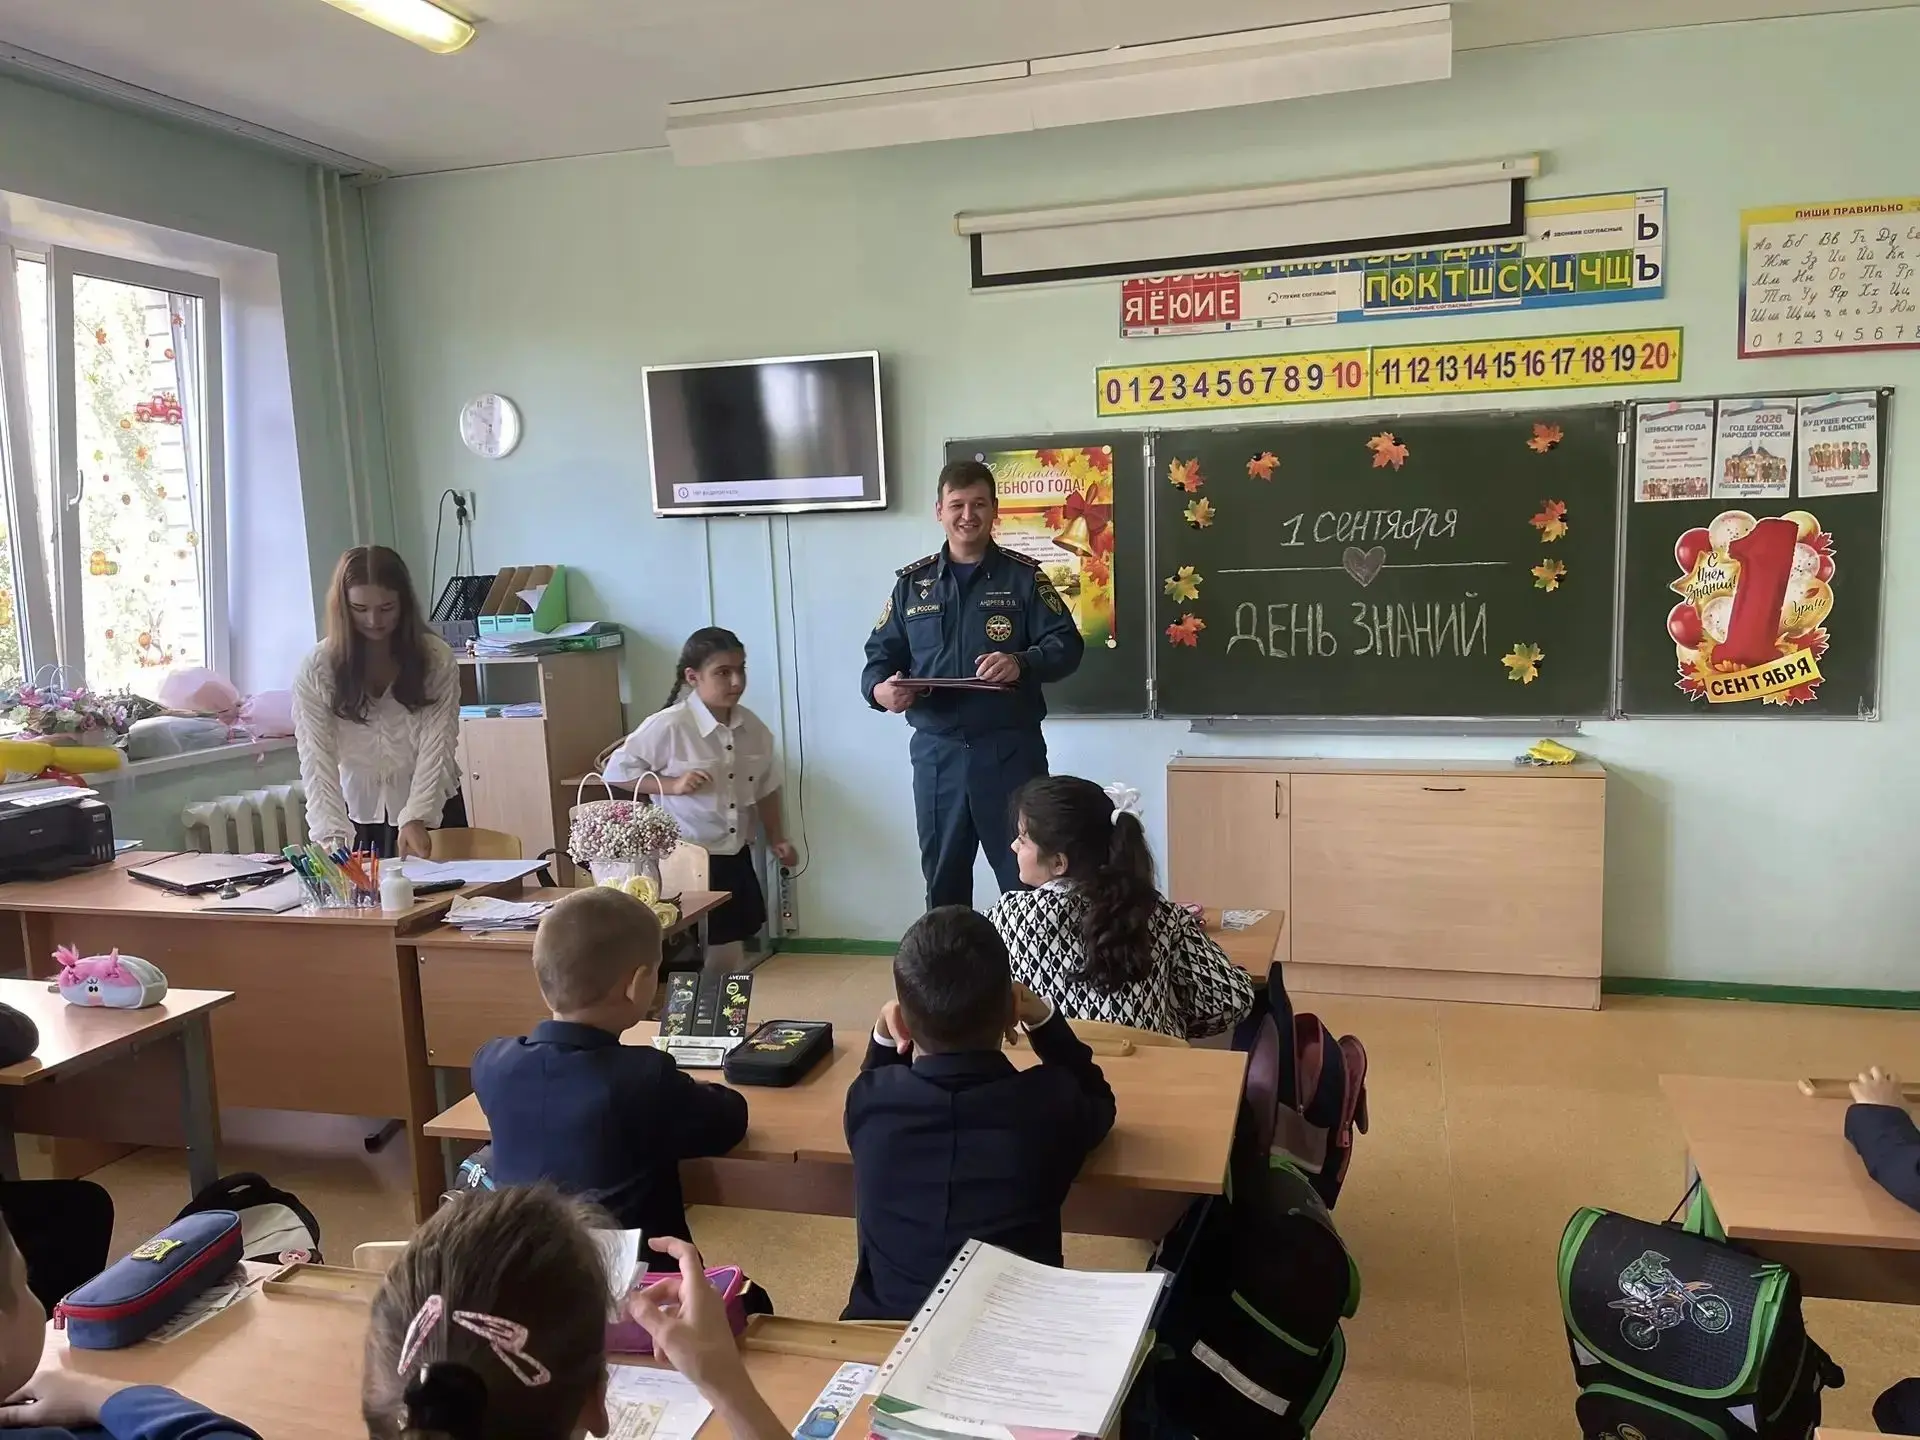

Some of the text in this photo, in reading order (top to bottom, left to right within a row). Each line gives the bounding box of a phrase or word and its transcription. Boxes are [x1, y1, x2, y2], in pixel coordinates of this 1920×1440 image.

[1795, 203, 1904, 219] ПИШИ ПРАВИЛЬНО
[1583, 226, 1623, 235] СОГЛАСНЫЕ
[1637, 213, 1659, 240] Ь
[1635, 254, 1660, 281] Ъ
[1302, 290, 1337, 298] СОГЛАСНЫЕ
[1752, 333, 1762, 348] 0
[1777, 332, 1783, 344] 1
[1794, 331, 1803, 345] 2
[1813, 330, 1823, 344] 3
[1835, 329, 1843, 341] 4
[1853, 327, 1864, 341] 5
[1874, 326, 1883, 340] 6
[1896, 325, 1904, 339] 7
[1381, 358, 1400, 384] 11
[1407, 357, 1430, 383] 12
[1435, 355, 1458, 382] 13
[1463, 353, 1488, 380] 14
[1492, 351, 1516, 378] 15
[1521, 350, 1545, 377] 16
[1551, 347, 1576, 375] 17
[1581, 346, 1605, 373] 18
[1611, 344, 1635, 372] 19
[1640, 342, 1669, 370] 20
[1755, 414, 1782, 424] 2026
[1802, 414, 1875, 427] БУДУЩЕЕ РОССИИ
[1828, 422, 1867, 432] ЕДИНСТВЕ
[1645, 423, 1707, 434] ЦЕННОСТИ ГОДА
[997, 478, 1085, 495] ЕБНОГО ГОДА!
[1280, 513, 1305, 546] 1
[1707, 552, 1718, 568] С
[1697, 566, 1725, 584] Днем
[917, 604, 939, 613] РОССИИ
[1784, 598, 1826, 626] Ура!!!
[1226, 591, 1489, 659] ДЕНЬ ЗНАНИЙ
[1711, 656, 1812, 696] СЕНТЯБРЯ
